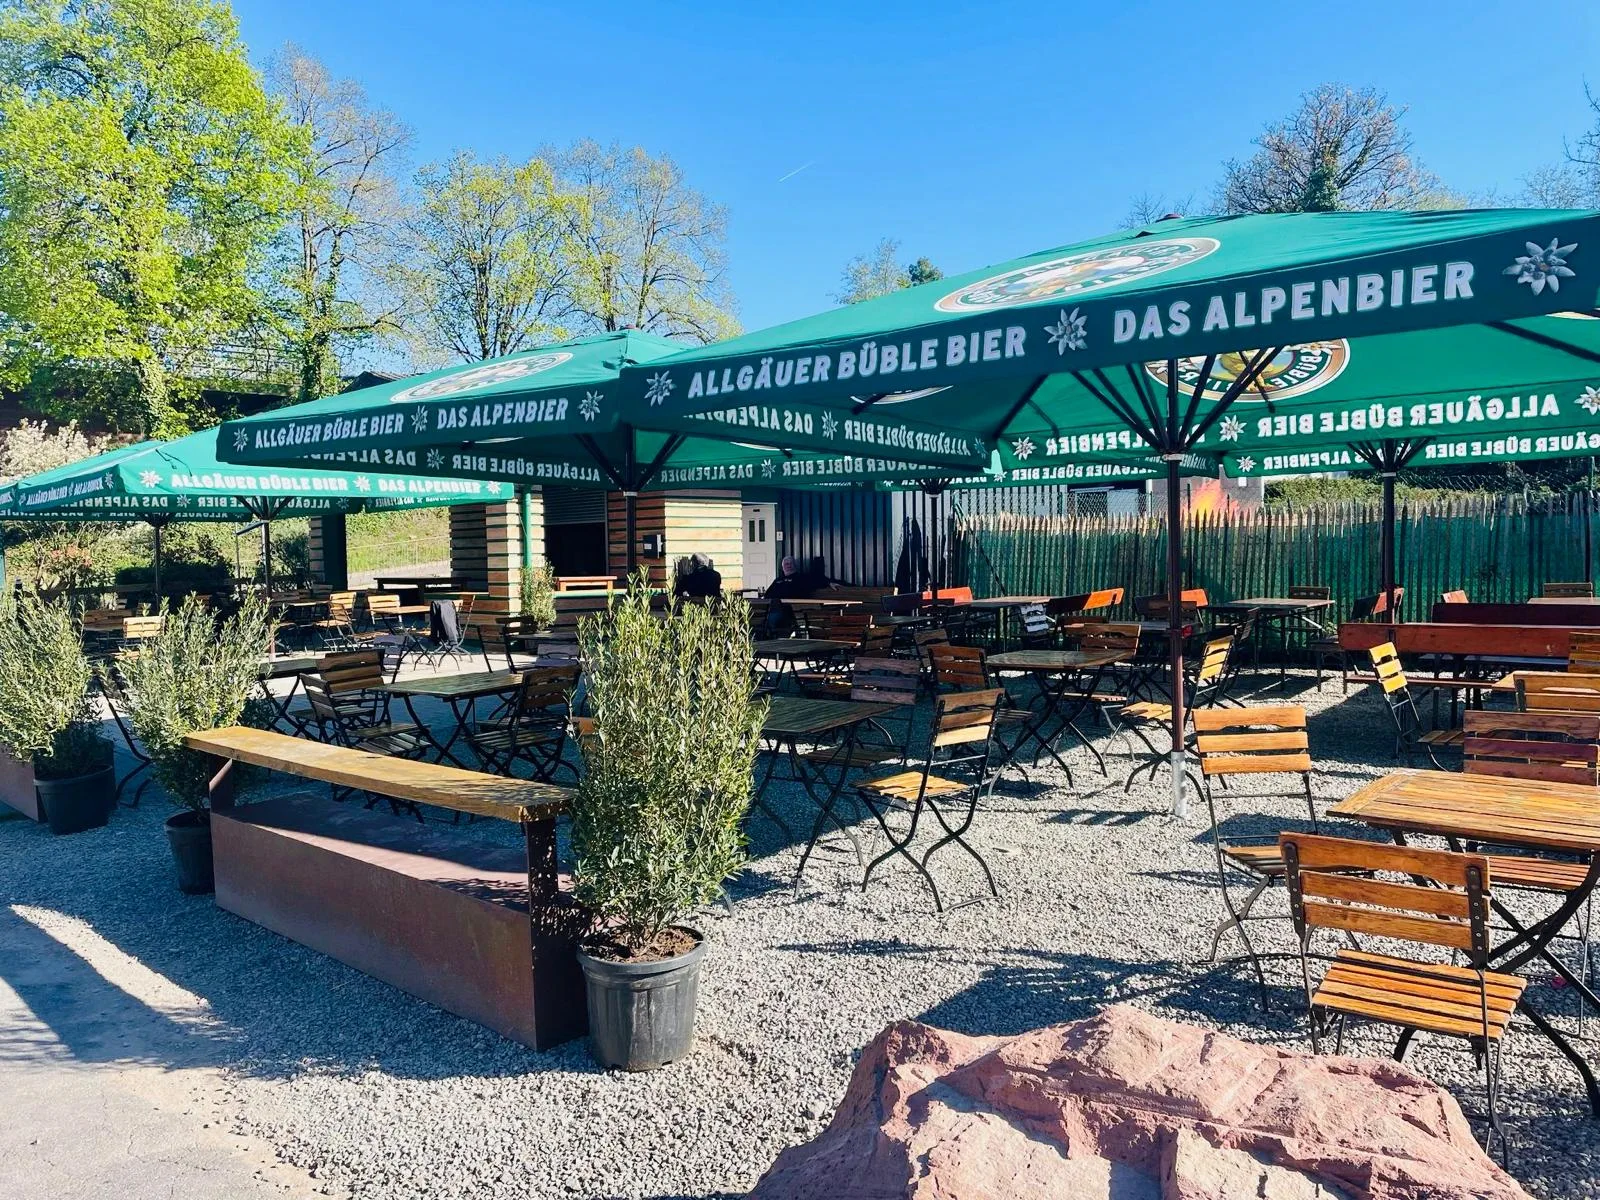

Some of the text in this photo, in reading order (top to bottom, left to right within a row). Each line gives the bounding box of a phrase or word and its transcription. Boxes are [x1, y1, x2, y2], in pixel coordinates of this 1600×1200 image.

[687, 260, 1475, 399] ALLGÄUER BÜBLE BIER DAS ALPENBIER
[255, 398, 569, 449] ALLGÄUER BÜBLE BIER DAS ALPENBIER
[171, 473, 481, 494] ALLGÄUER BÜBLE BIER DAS ALPENBIER
